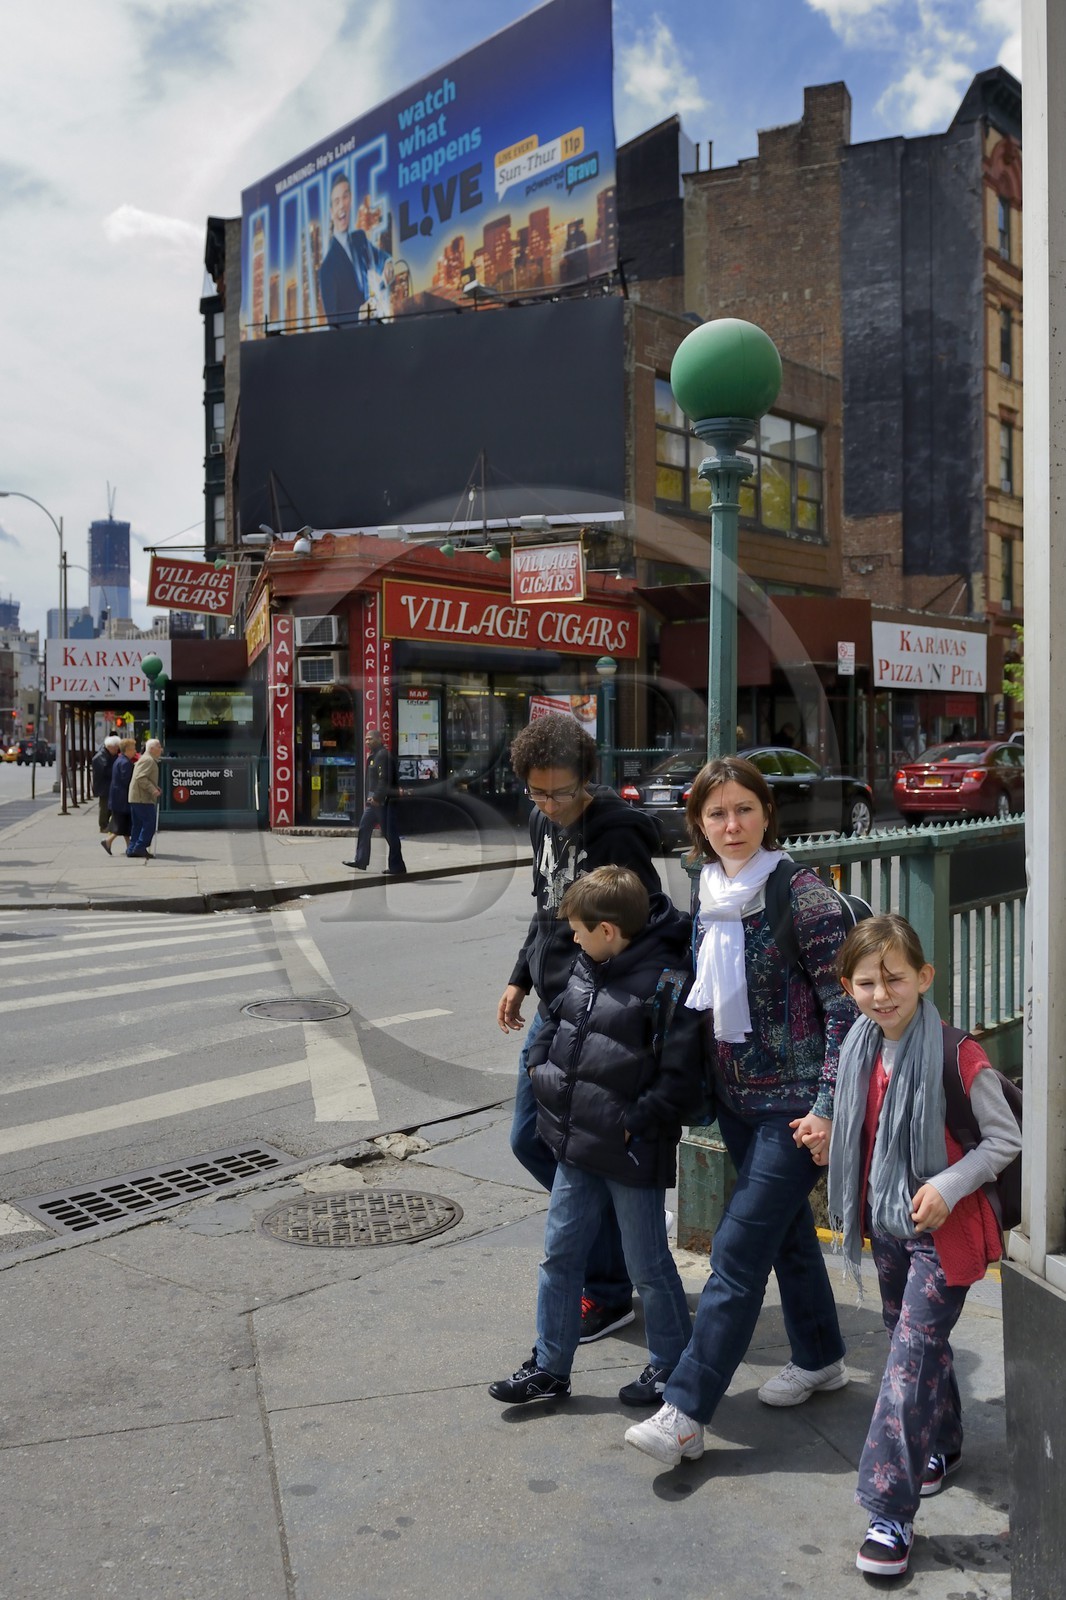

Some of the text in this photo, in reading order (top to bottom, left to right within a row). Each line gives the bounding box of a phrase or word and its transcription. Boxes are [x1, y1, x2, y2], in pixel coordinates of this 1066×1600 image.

[398, 78, 456, 130] watch
[398, 113, 447, 159] what
[564, 137, 580, 154] 11p
[398, 127, 482, 189] happens
[498, 147, 556, 185] Sun-Thur
[275, 163, 315, 195] WARNING:
[567, 158, 597, 186] Bravo
[514, 552, 577, 572] VILLAGE
[156, 566, 232, 589] VILLAGE
[520, 574, 573, 594] CIGARS
[154, 583, 229, 610] CIGARS
[400, 595, 630, 651] VILLAGE CIGARS
[62, 647, 157, 667] KARAVA
[900, 630, 967, 657] KARAVAS
[276, 619, 289, 719] CANDY
[878, 659, 923, 683] PIZZA
[951, 664, 983, 686] PITA
[50, 676, 101, 691] PIZZA
[172, 769, 233, 779] Christopher St
[172, 778, 203, 786] Station
[276, 745, 290, 823] SODA
[178, 790, 184, 799] 1
